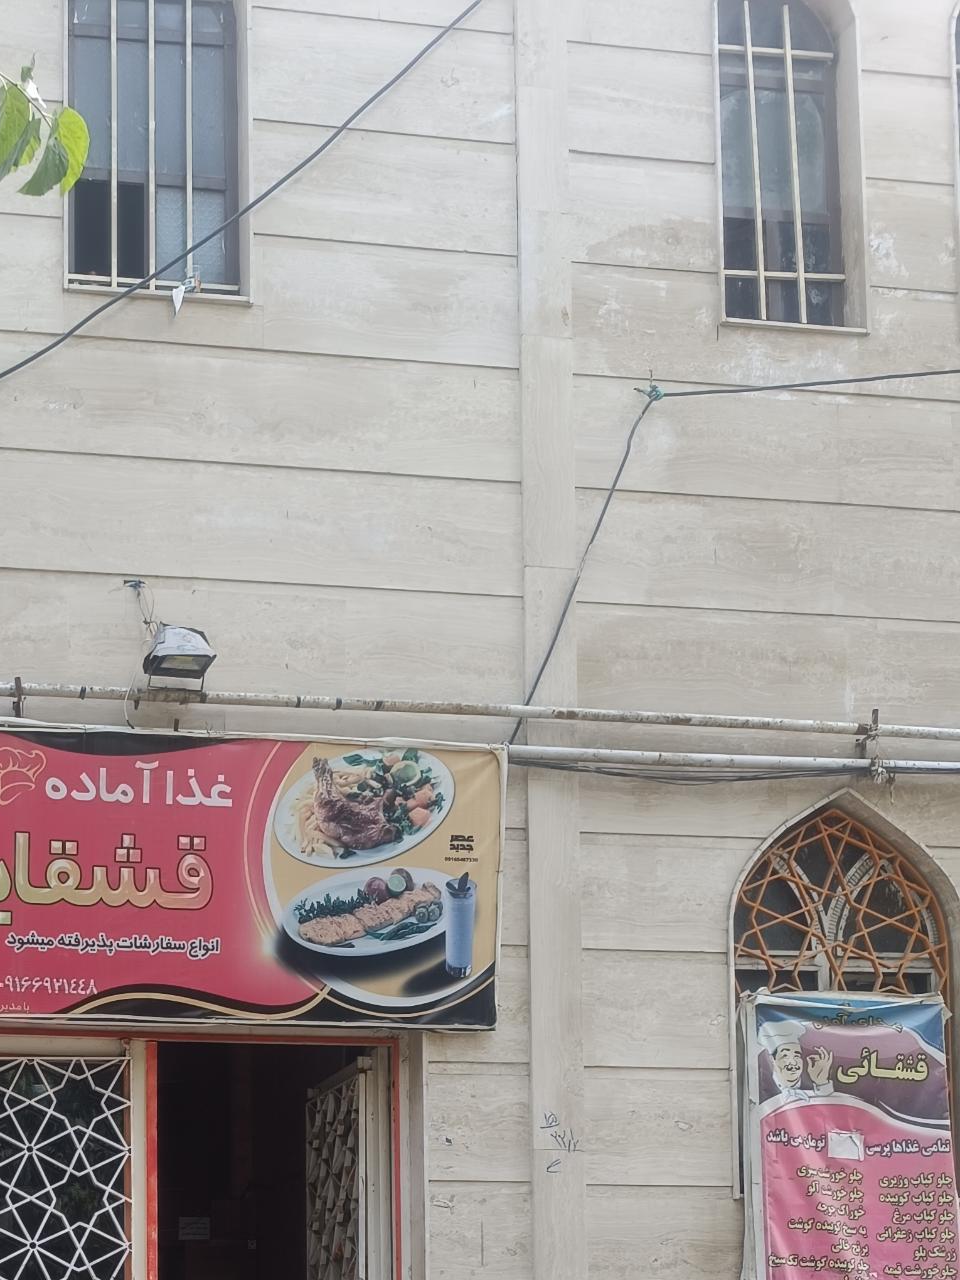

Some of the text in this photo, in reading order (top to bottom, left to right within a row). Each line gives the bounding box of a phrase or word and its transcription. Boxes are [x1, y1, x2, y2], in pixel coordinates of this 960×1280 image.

[45, 760, 234, 808] غذا آماده
[5, 931, 221, 960] انواع سفارشات پذیرفته میشود
[837, 1046, 928, 1084] قشقائی
[766, 1129, 790, 1146] باشد
[866, 1138, 951, 1158] تمامی غذاها پرسی
[847, 1167, 863, 1185] چلو
[879, 1172, 953, 1189] چلو کباب وزیری
[848, 1186, 864, 1203] چلو
[879, 1190, 955, 1207] چلو کباب کوبیده
[892, 1208, 956, 1225] چلو کباب مرغ
[876, 1226, 956, 1243] چلو کباب زعفرانی
[913, 1245, 957, 1262] زرشک پلو
[883, 1262, 958, 1280] چلو خورشت قیمه
